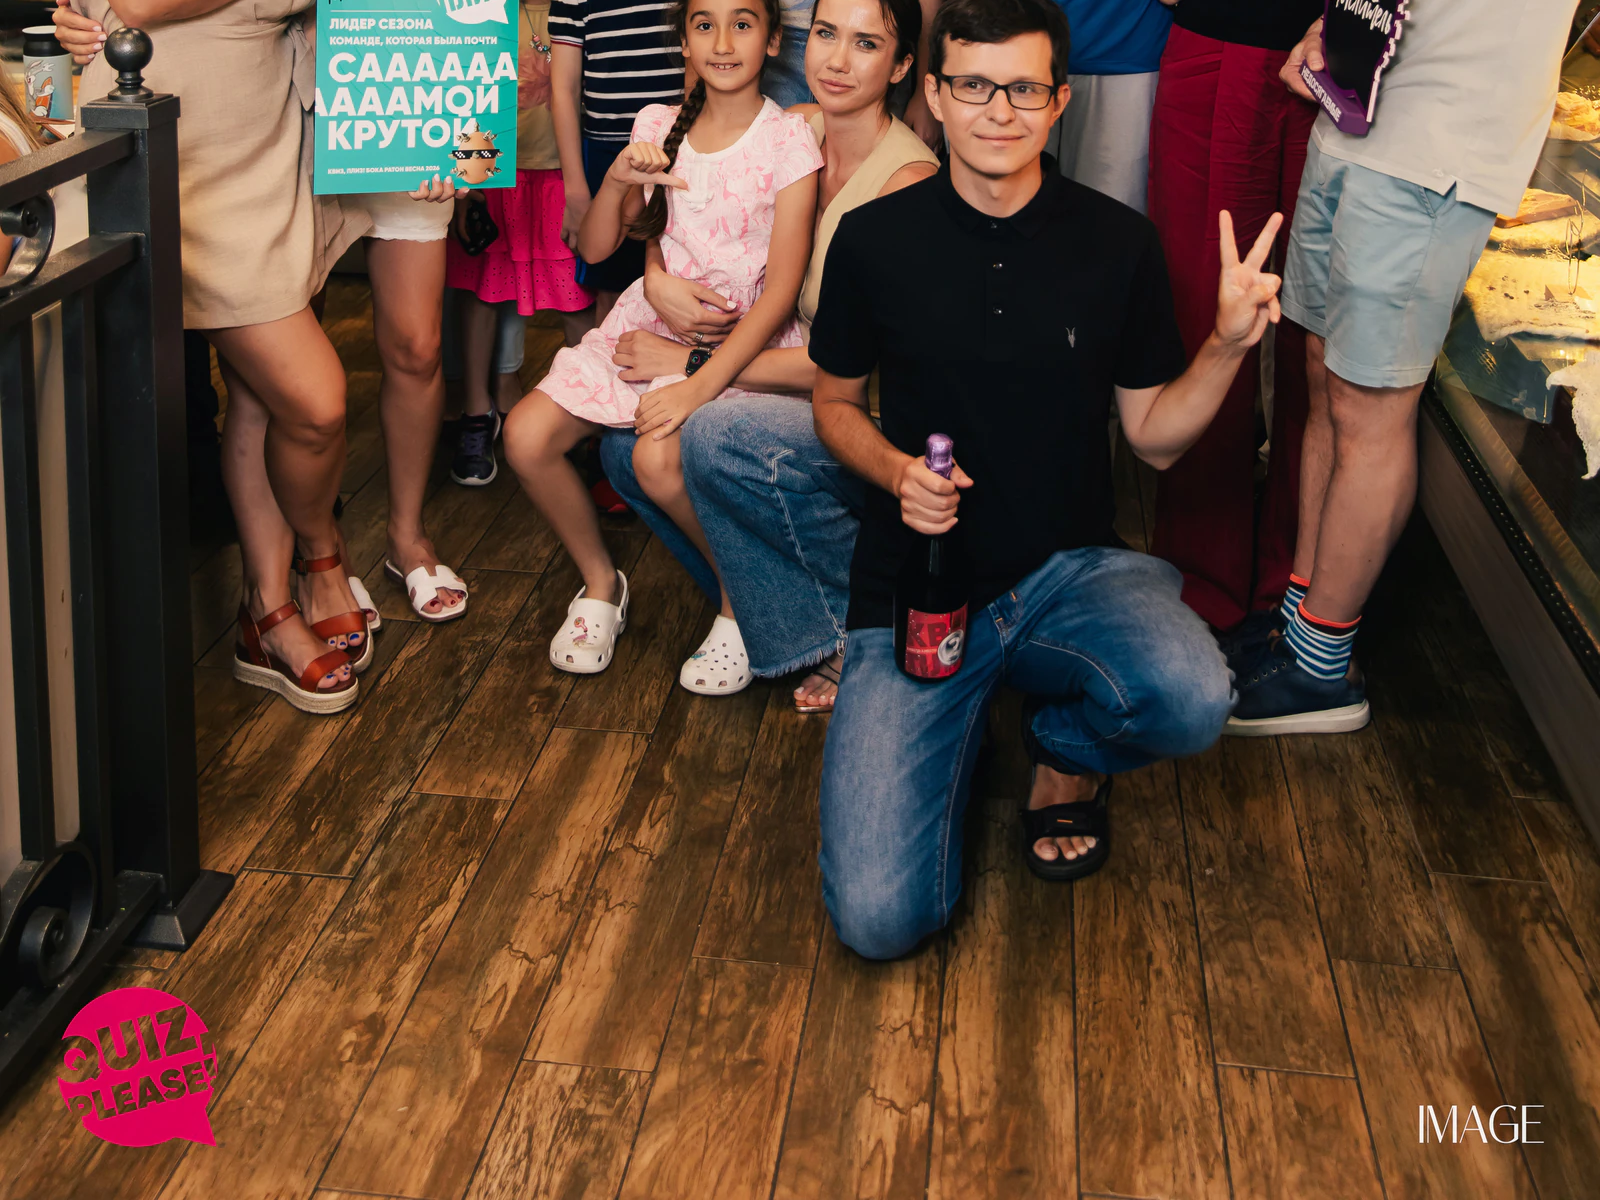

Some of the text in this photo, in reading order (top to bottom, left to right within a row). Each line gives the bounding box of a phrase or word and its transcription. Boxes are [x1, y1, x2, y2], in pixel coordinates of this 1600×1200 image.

[329, 18, 434, 31] ЛИДЕР СЕЗОНА
[329, 36, 498, 47] КОМАНДЕ, КОТОРАЯ БЫЛА ПОЧТИ
[328, 52, 517, 83] САААААА
